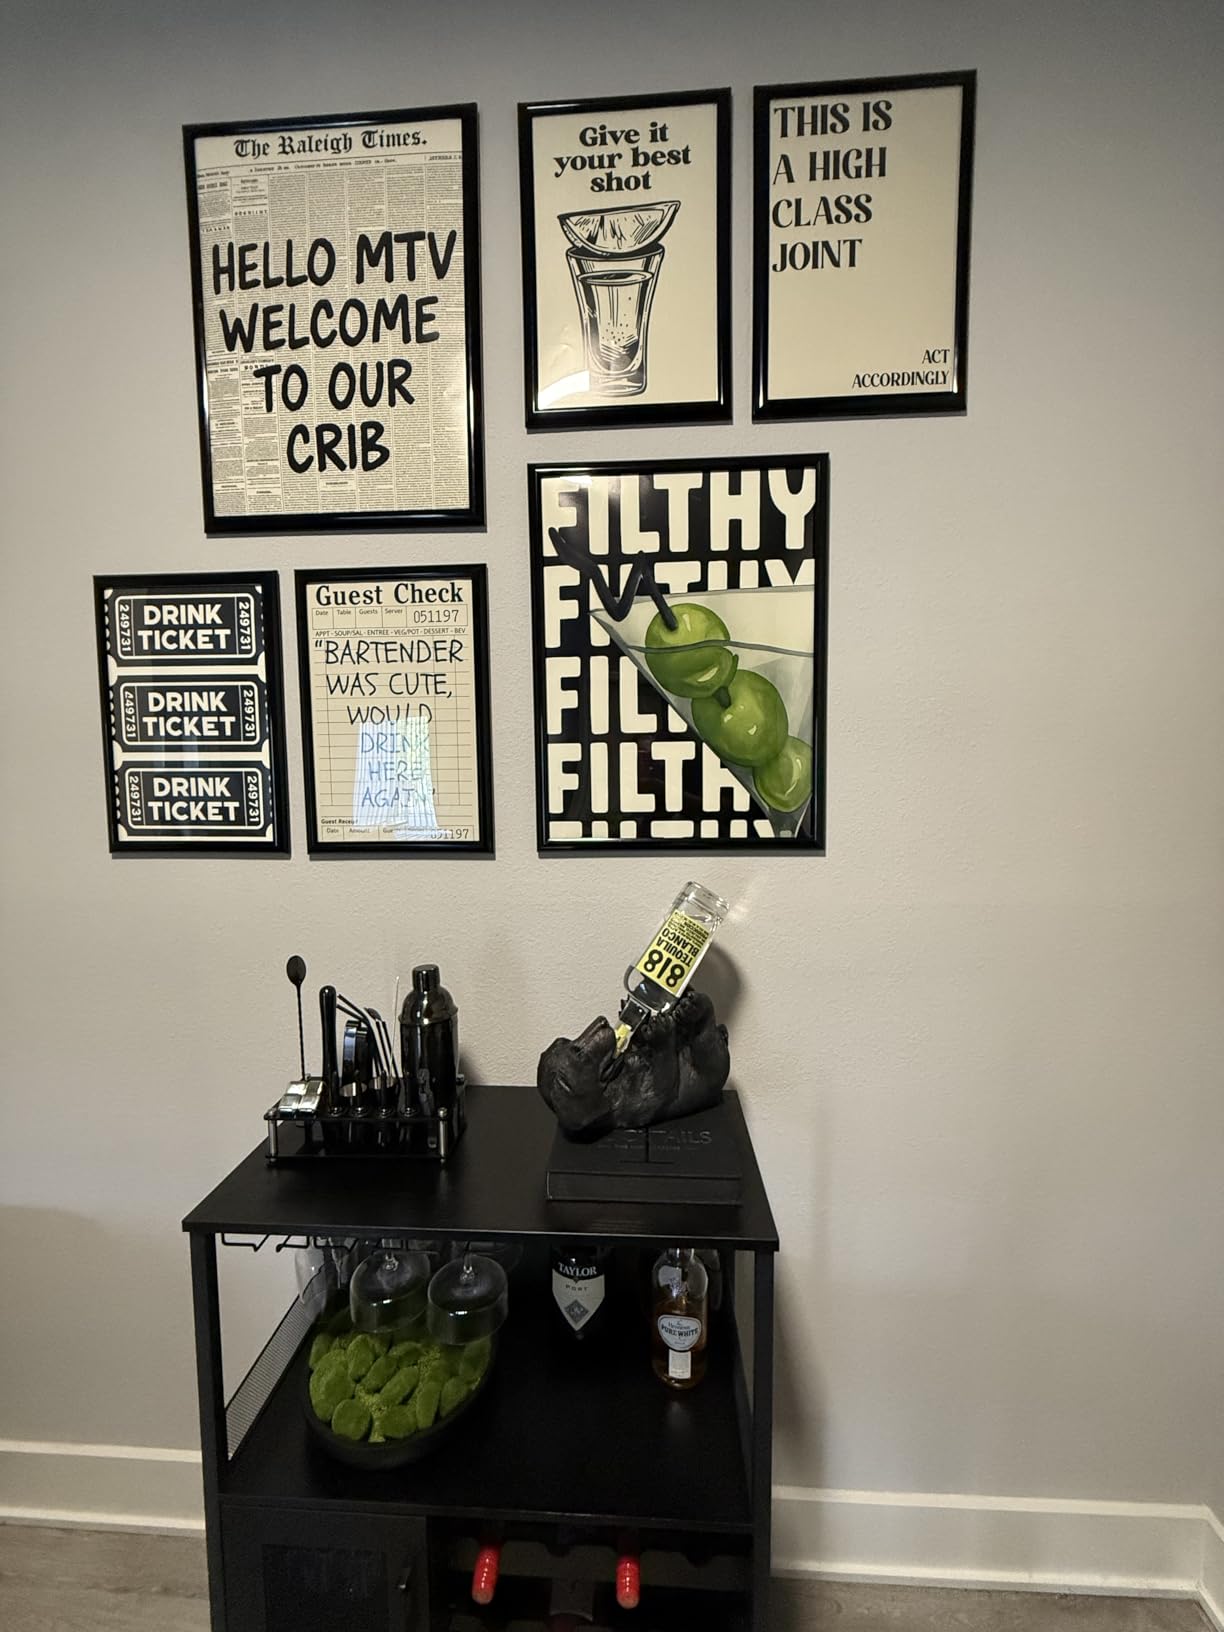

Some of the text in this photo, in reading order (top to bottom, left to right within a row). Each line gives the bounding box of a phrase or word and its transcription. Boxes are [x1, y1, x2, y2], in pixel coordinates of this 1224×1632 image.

[773, 99, 893, 139] THIS IS
[233, 129, 428, 160] The Raleigh Times.
[579, 121, 669, 149] Give it
[554, 144, 692, 178] your best
[772, 146, 887, 185] A HIGH
[590, 170, 652, 193] shot
[771, 193, 873, 228] CLASS
[212, 229, 457, 295] HELLO MTV
[771, 239, 863, 273] JOINT
[219, 293, 440, 353] WELCOME
[921, 348, 950, 364] ACT
[253, 358, 415, 412] TO OUR
[852, 370, 950, 389] ACCORDINGLY
[287, 420, 390, 474] CRIB
[541, 468, 816, 556] FILTHY
[316, 582, 463, 606] Guest Check
[119, 604, 131, 652] 249731
[143, 604, 223, 625] DRINK
[238, 601, 251, 651] 249731
[359, 607, 379, 615] Guests
[384, 607, 403, 615] Server
[413, 609, 460, 624] 051197
[137, 629, 231, 650] TICKET
[393, 628, 420, 636] VEG/POT
[423, 627, 449, 635] DESSERT
[454, 626, 466, 634] BEV
[326, 672, 453, 698] WAS CUTE,
[147, 691, 228, 713] DRINK
[243, 689, 256, 738] 249731
[346, 703, 433, 726] WOULD
[142, 716, 236, 737] TICKET
[360, 731, 431, 754] DRINK
[368, 760, 423, 781] HERE
[129, 775, 141, 823] 249731
[153, 777, 231, 798] DRINK
[247, 775, 260, 823] 249731
[148, 801, 240, 821] TICKET
[656, 936, 693, 968] TEQUILA
[661, 927, 700, 957] BLANCO
[643, 949, 685, 988] 818
[558, 1262, 598, 1277] TAYLOR
[565, 1284, 589, 1292] PORT
[678, 1327, 699, 1337] WHITE
